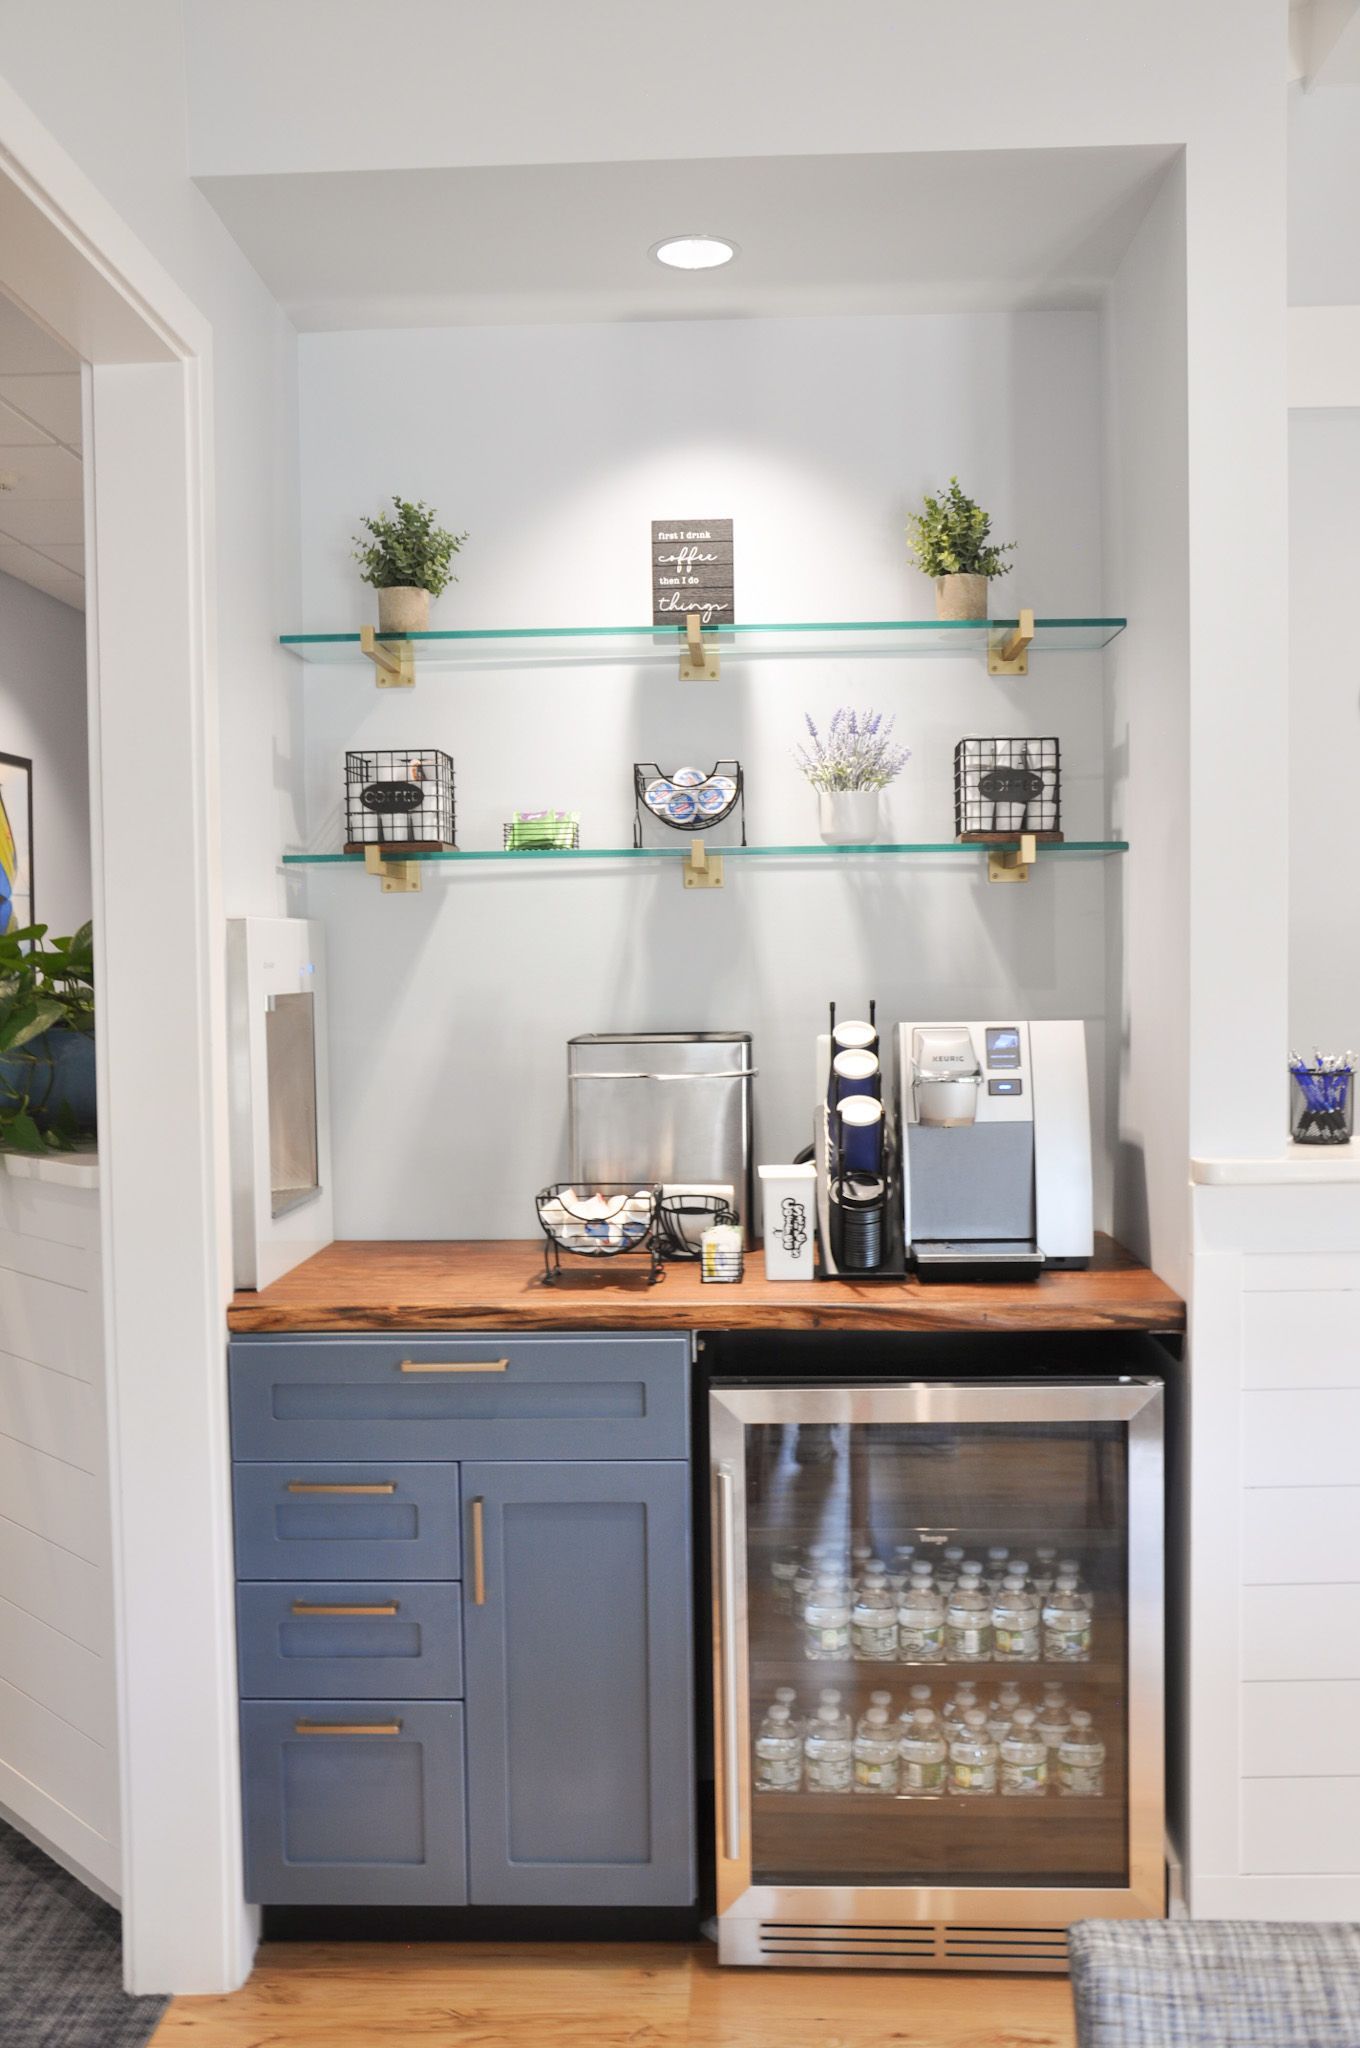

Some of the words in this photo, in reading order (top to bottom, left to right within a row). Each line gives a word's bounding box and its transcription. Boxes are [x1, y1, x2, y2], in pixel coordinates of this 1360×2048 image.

[658, 532, 678, 540] first
[680, 531, 684, 539] I
[686, 531, 711, 539] drink
[658, 546, 718, 573] coffee
[659, 577, 680, 585] then
[682, 576, 686, 584] I
[688, 576, 699, 584] do
[658, 592, 728, 623] things
